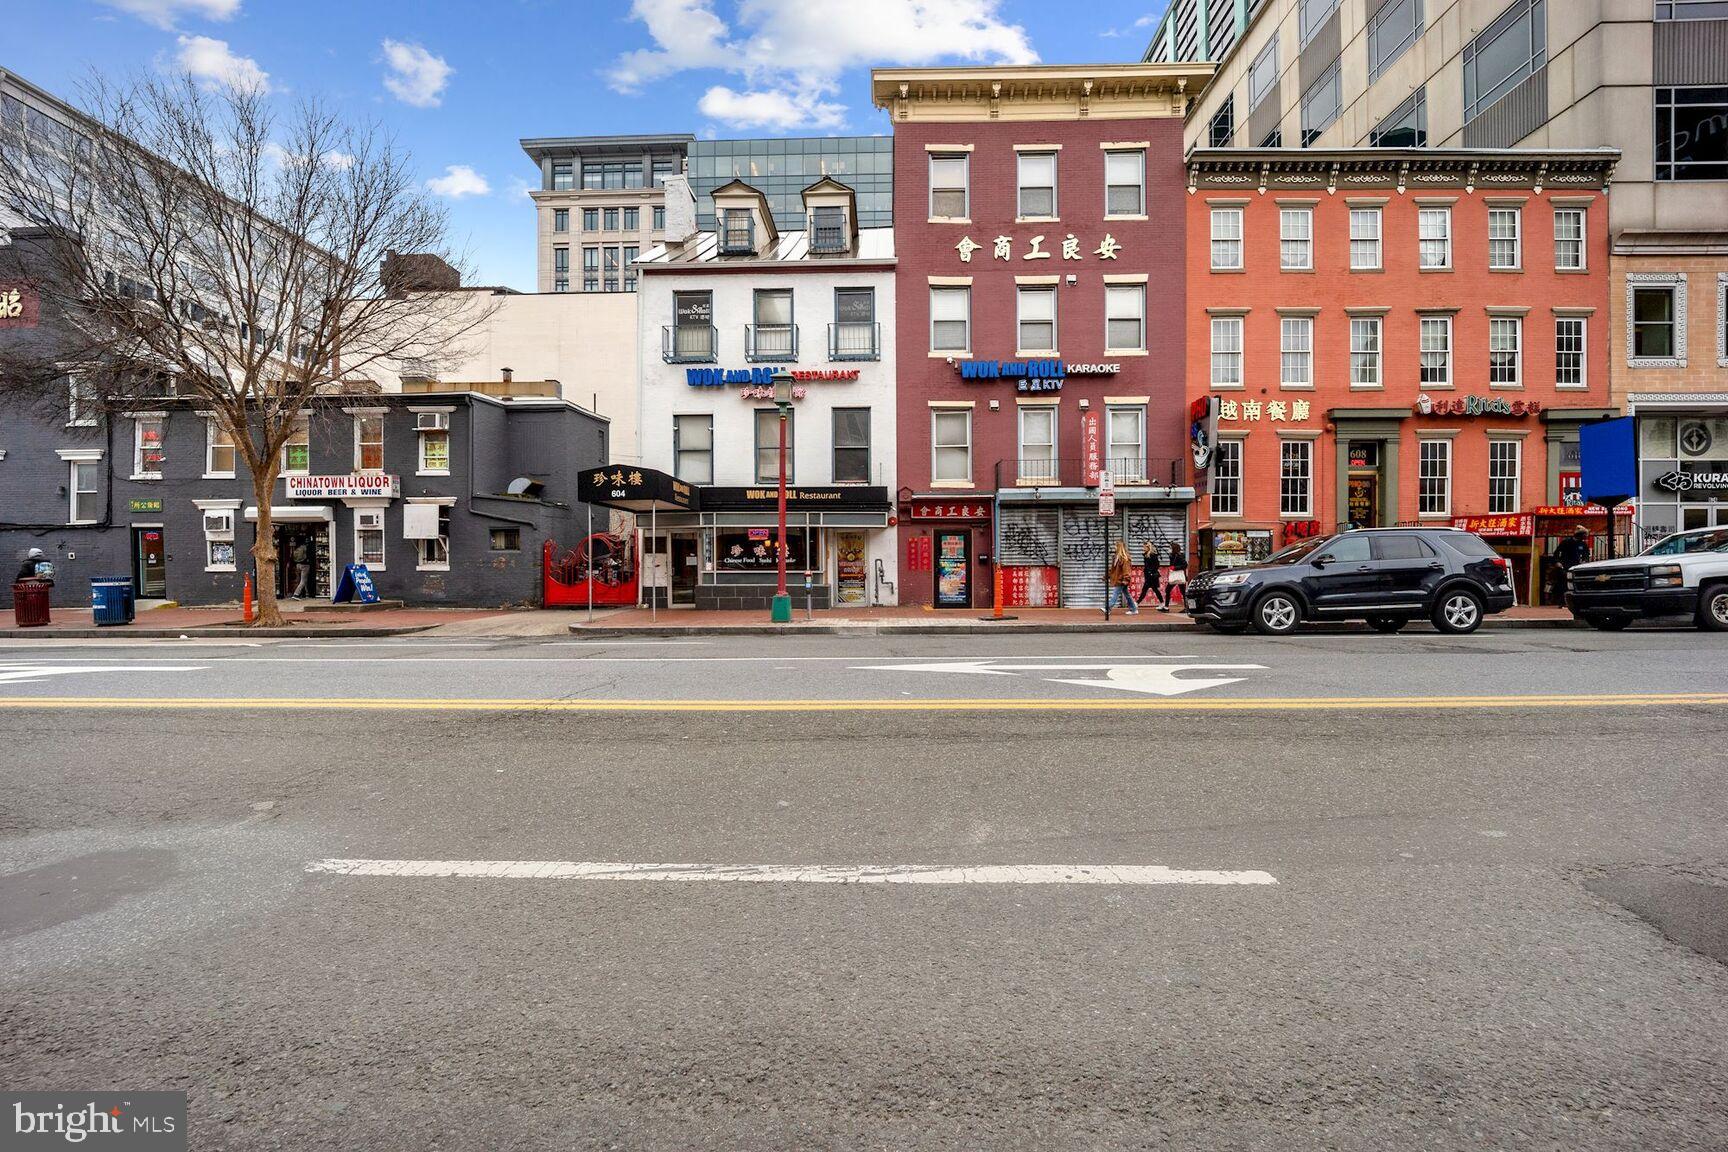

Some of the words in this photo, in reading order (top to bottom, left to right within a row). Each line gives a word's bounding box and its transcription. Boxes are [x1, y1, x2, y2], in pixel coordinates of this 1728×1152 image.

[961, 360, 999, 378] WOK
[1002, 362, 1027, 376] AND
[1027, 360, 1066, 378] ROLL
[1067, 363, 1121, 373] KARAOKE
[686, 367, 724, 386] WOK
[727, 369, 750, 383] AND
[1217, 398, 1310, 422] 越南餐廳
[1350, 449, 1367, 459] 608
[290, 477, 345, 489] CHINATOWN
[348, 476, 390, 488] LIQUOR
[1693, 473, 1728, 483] KURA
[611, 490, 625, 498] 604
[746, 490, 766, 499] WOK
[766, 491, 778, 499] AND
[800, 491, 841, 499] Restaurant
